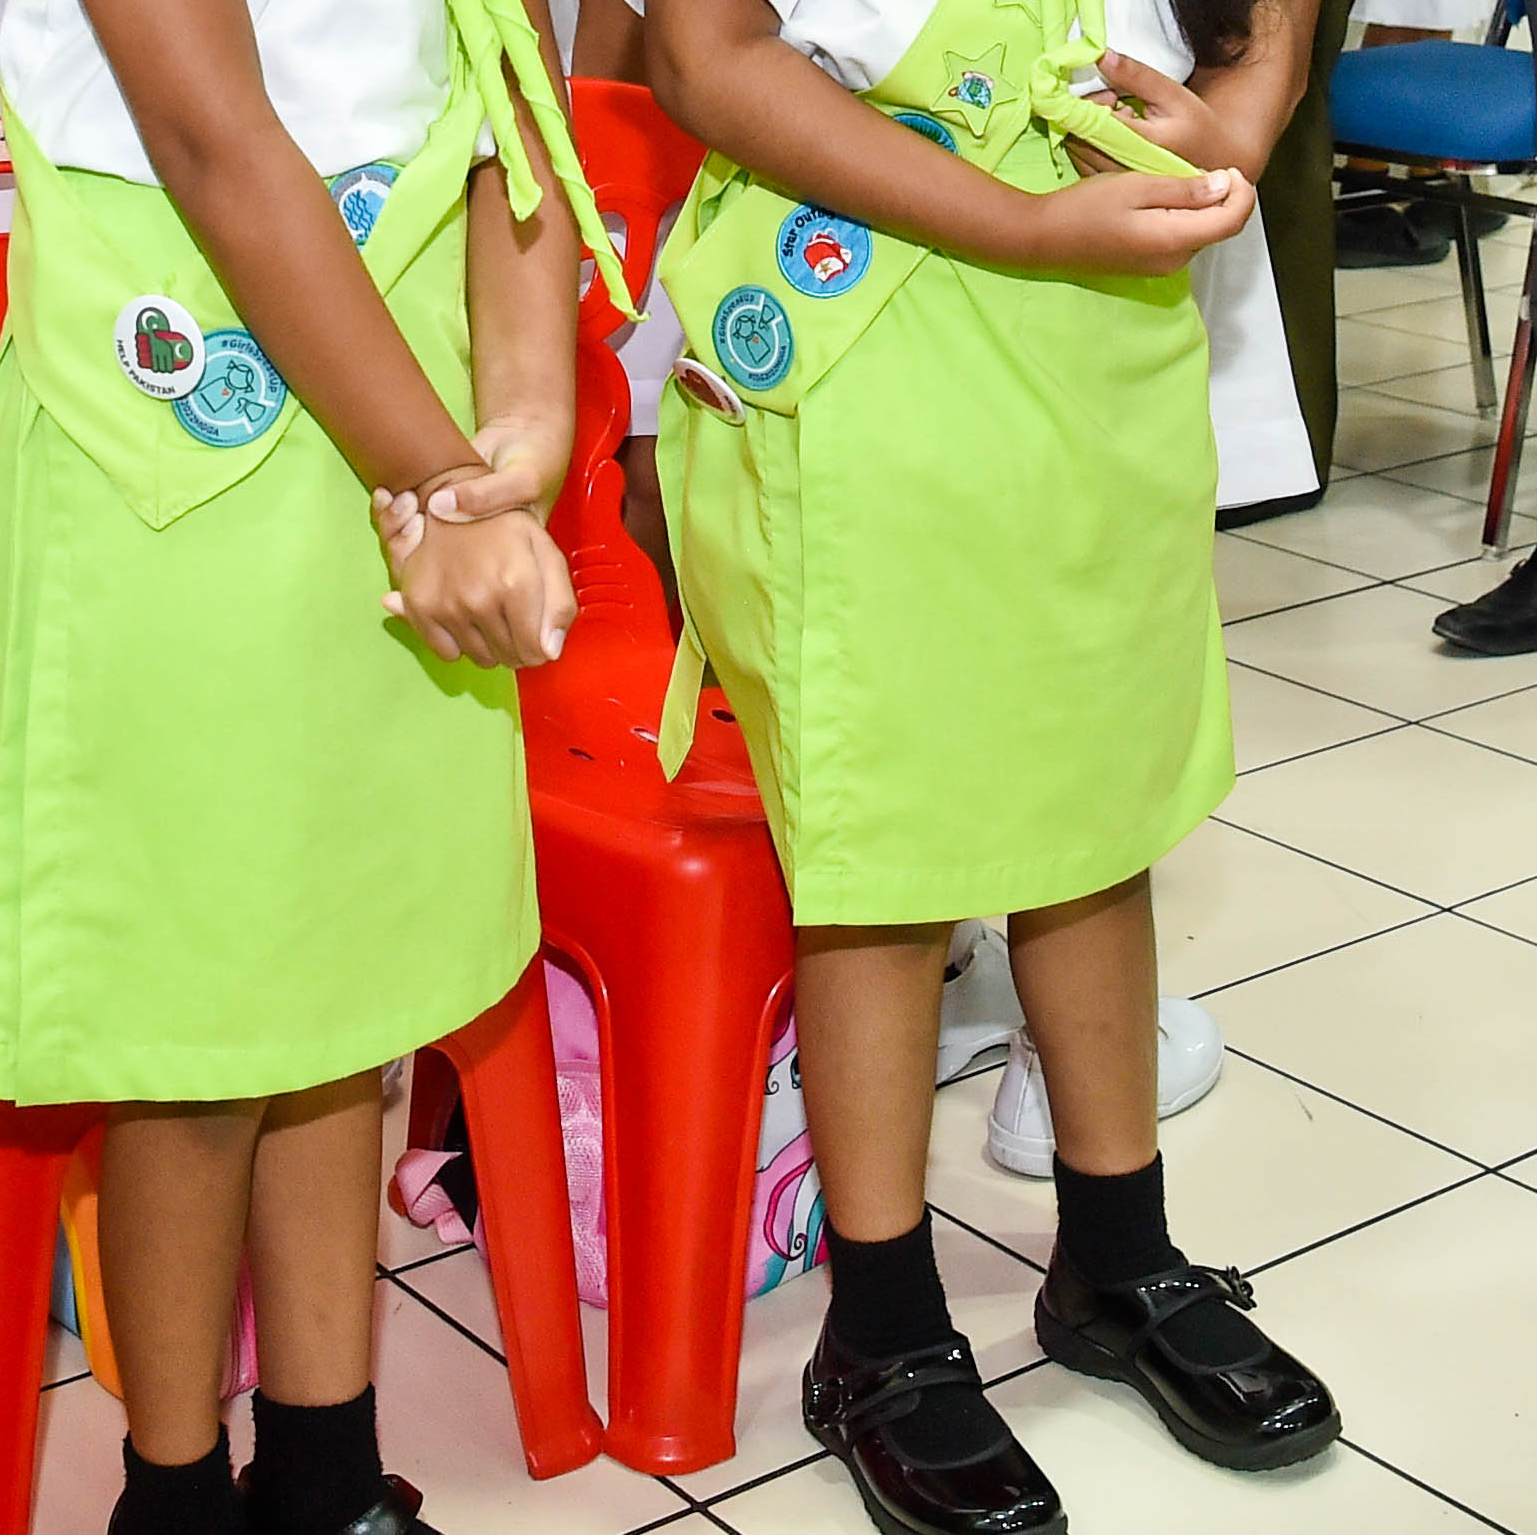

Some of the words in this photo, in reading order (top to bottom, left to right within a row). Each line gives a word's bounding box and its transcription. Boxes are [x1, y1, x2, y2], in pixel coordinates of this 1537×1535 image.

[782, 228, 798, 258] Star
[116, 339, 130, 368] HELP
[128, 369, 176, 396] PAKISTAN
